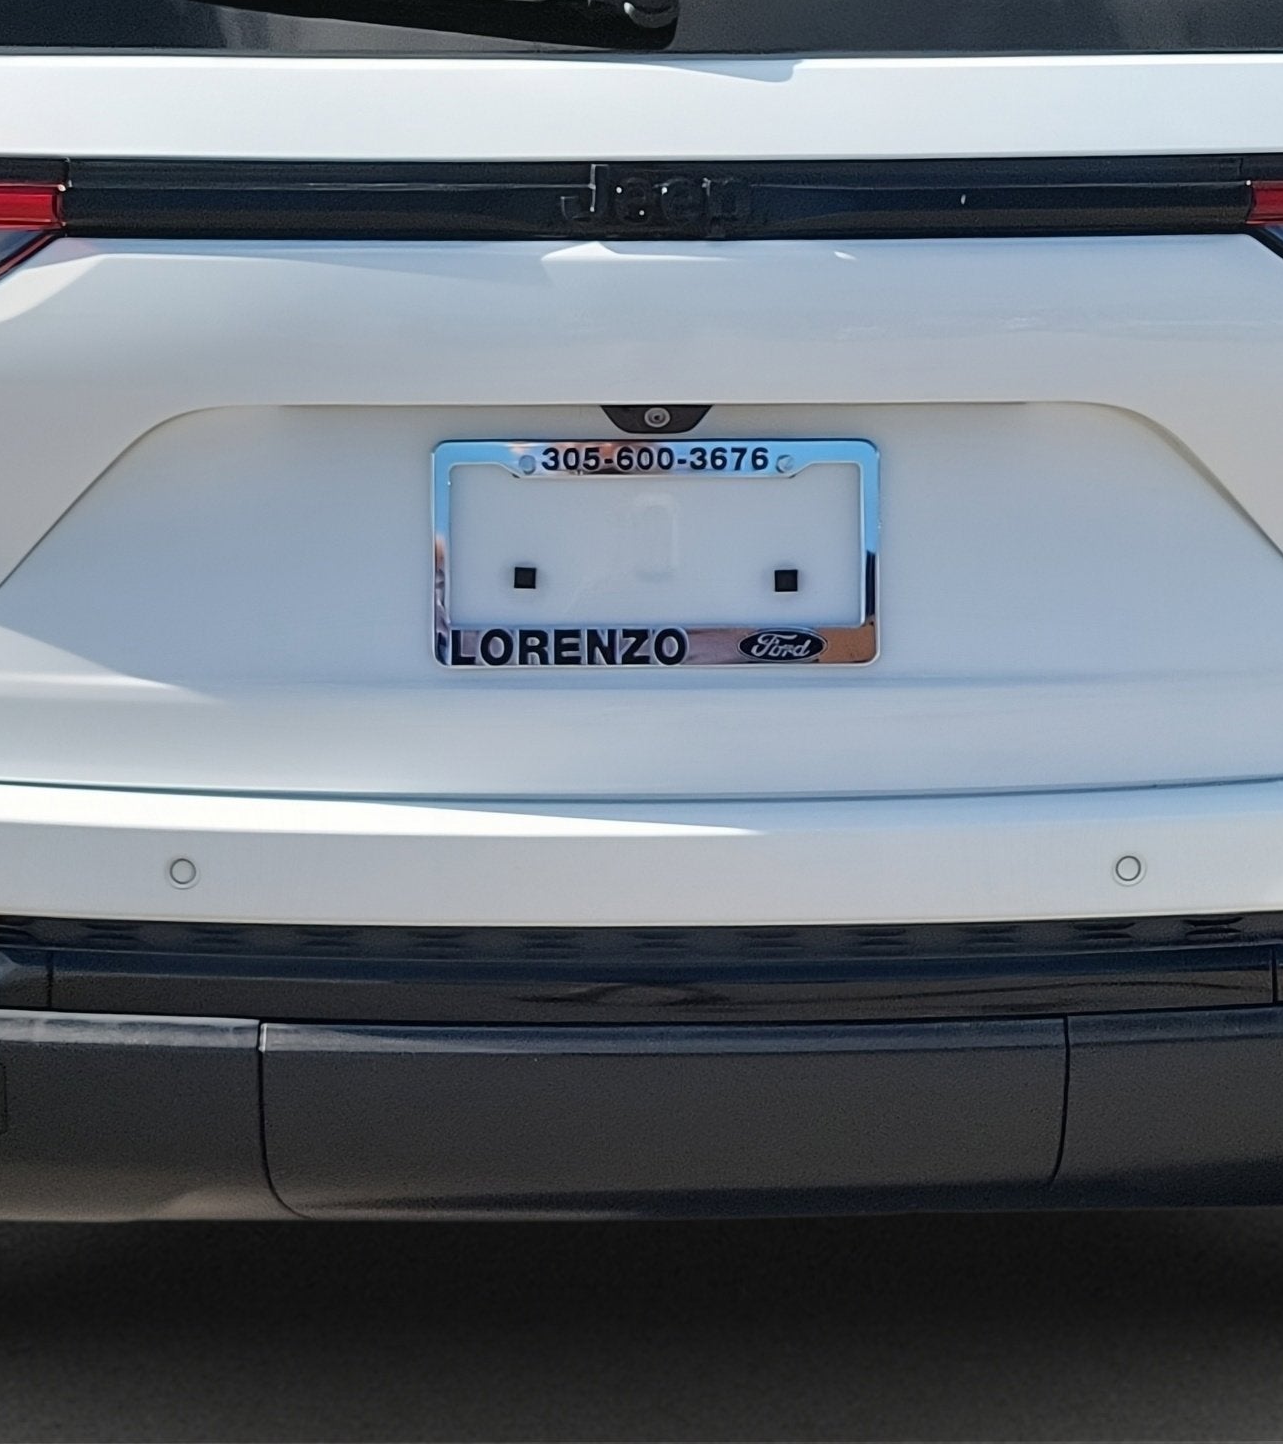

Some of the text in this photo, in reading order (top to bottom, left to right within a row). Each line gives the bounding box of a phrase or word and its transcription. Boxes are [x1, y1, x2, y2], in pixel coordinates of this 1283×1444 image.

[541, 446, 770, 472] 305-600-3676
[450, 628, 811, 666] LORENZO Ford
